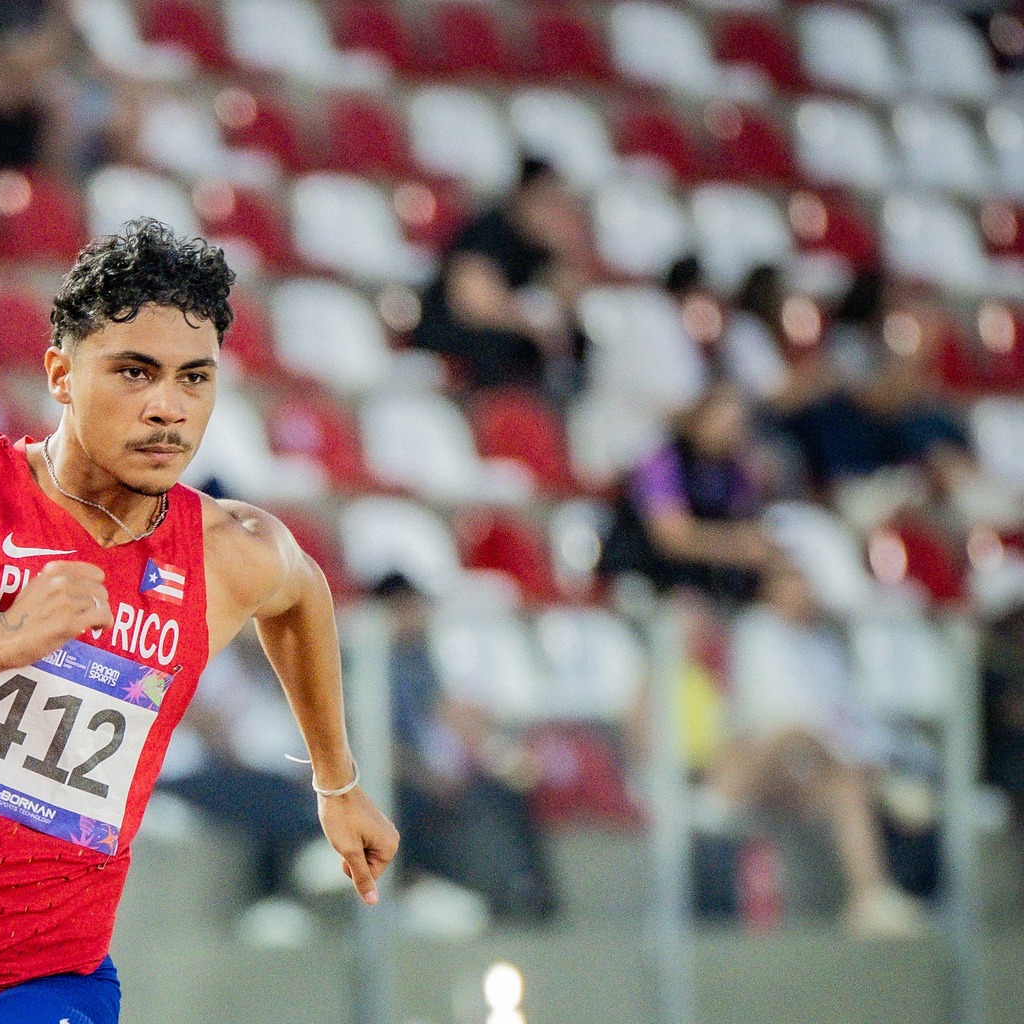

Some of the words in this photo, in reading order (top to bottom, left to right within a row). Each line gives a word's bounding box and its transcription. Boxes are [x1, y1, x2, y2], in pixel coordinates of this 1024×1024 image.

[111, 602, 180, 666] RICO
[88, 670, 118, 687] SPORTS
[91, 662, 121, 680] PANAM
[0, 790, 57, 820] BORNAN
